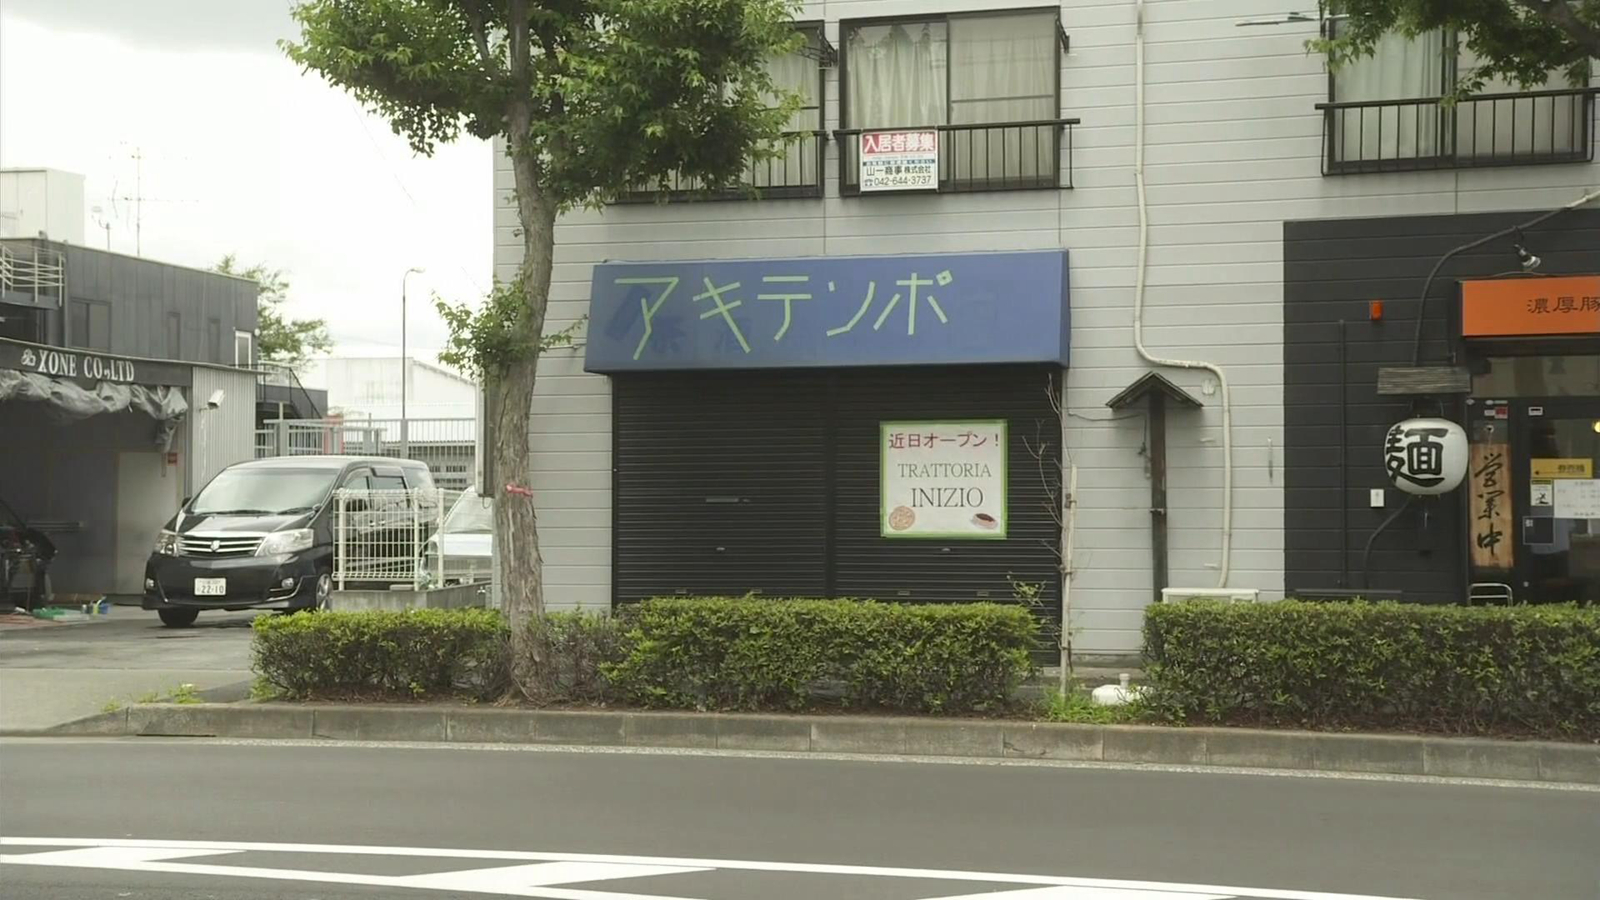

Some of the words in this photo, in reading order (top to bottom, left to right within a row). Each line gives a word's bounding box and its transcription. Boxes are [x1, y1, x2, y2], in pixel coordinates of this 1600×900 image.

[863, 132, 934, 152] 入居者募集
[613, 269, 953, 361] アキテンポ
[37, 349, 77, 377] XONE
[898, 463, 991, 477] TRATTORIA
[911, 487, 984, 508] INIZIO
[1474, 453, 1504, 556] 営業中
